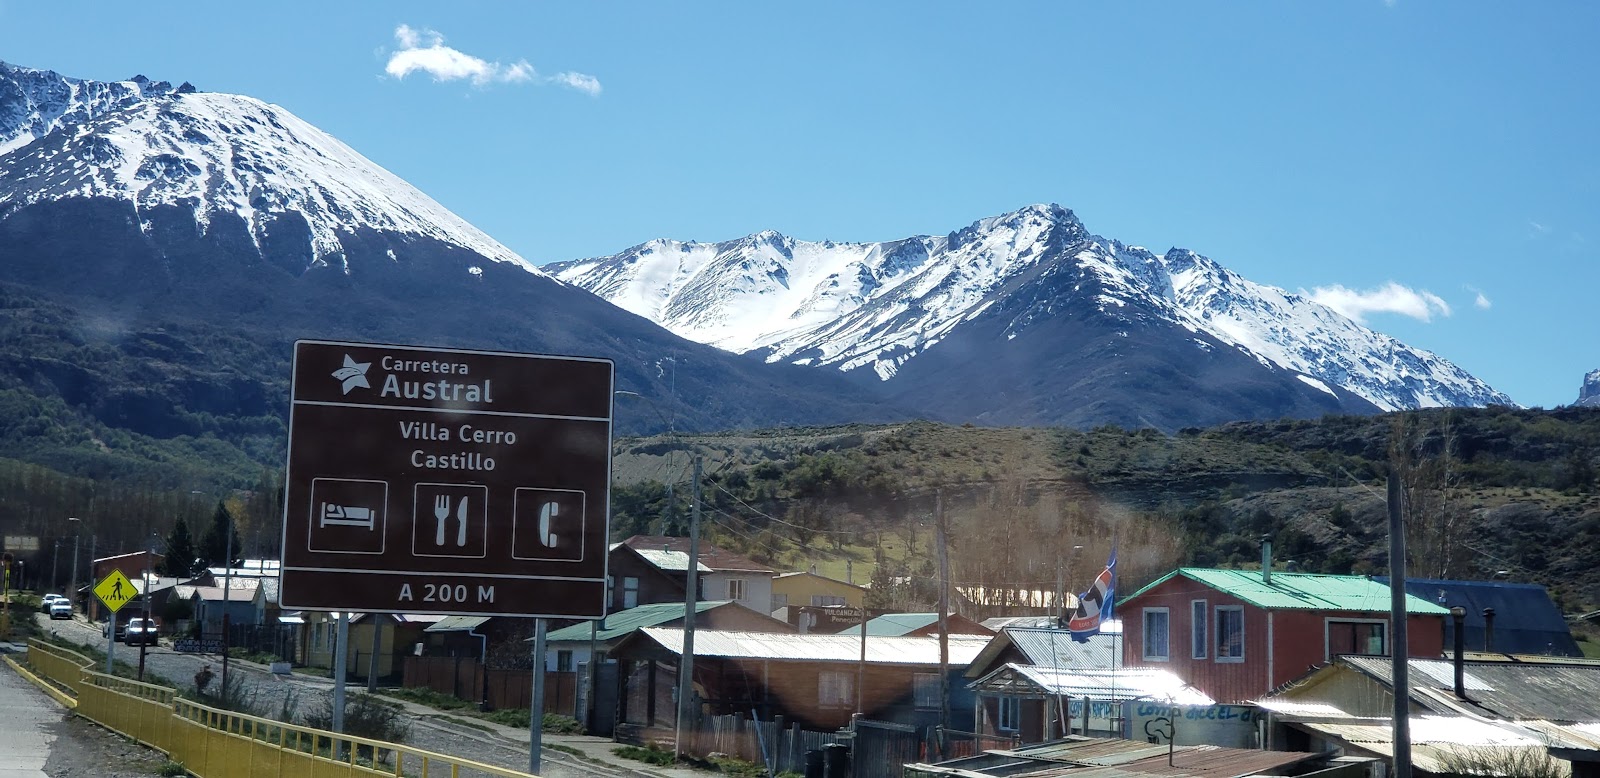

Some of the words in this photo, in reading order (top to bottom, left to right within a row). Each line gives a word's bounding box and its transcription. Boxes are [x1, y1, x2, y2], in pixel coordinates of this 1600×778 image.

[381, 356, 469, 375] Carretera
[381, 374, 493, 403] Austral
[399, 421, 450, 441] Villa
[459, 424, 517, 445] Cerro
[411, 450, 496, 471] Castillo
[398, 584, 413, 601] A
[423, 584, 467, 602] 200
[478, 585, 495, 603] M
